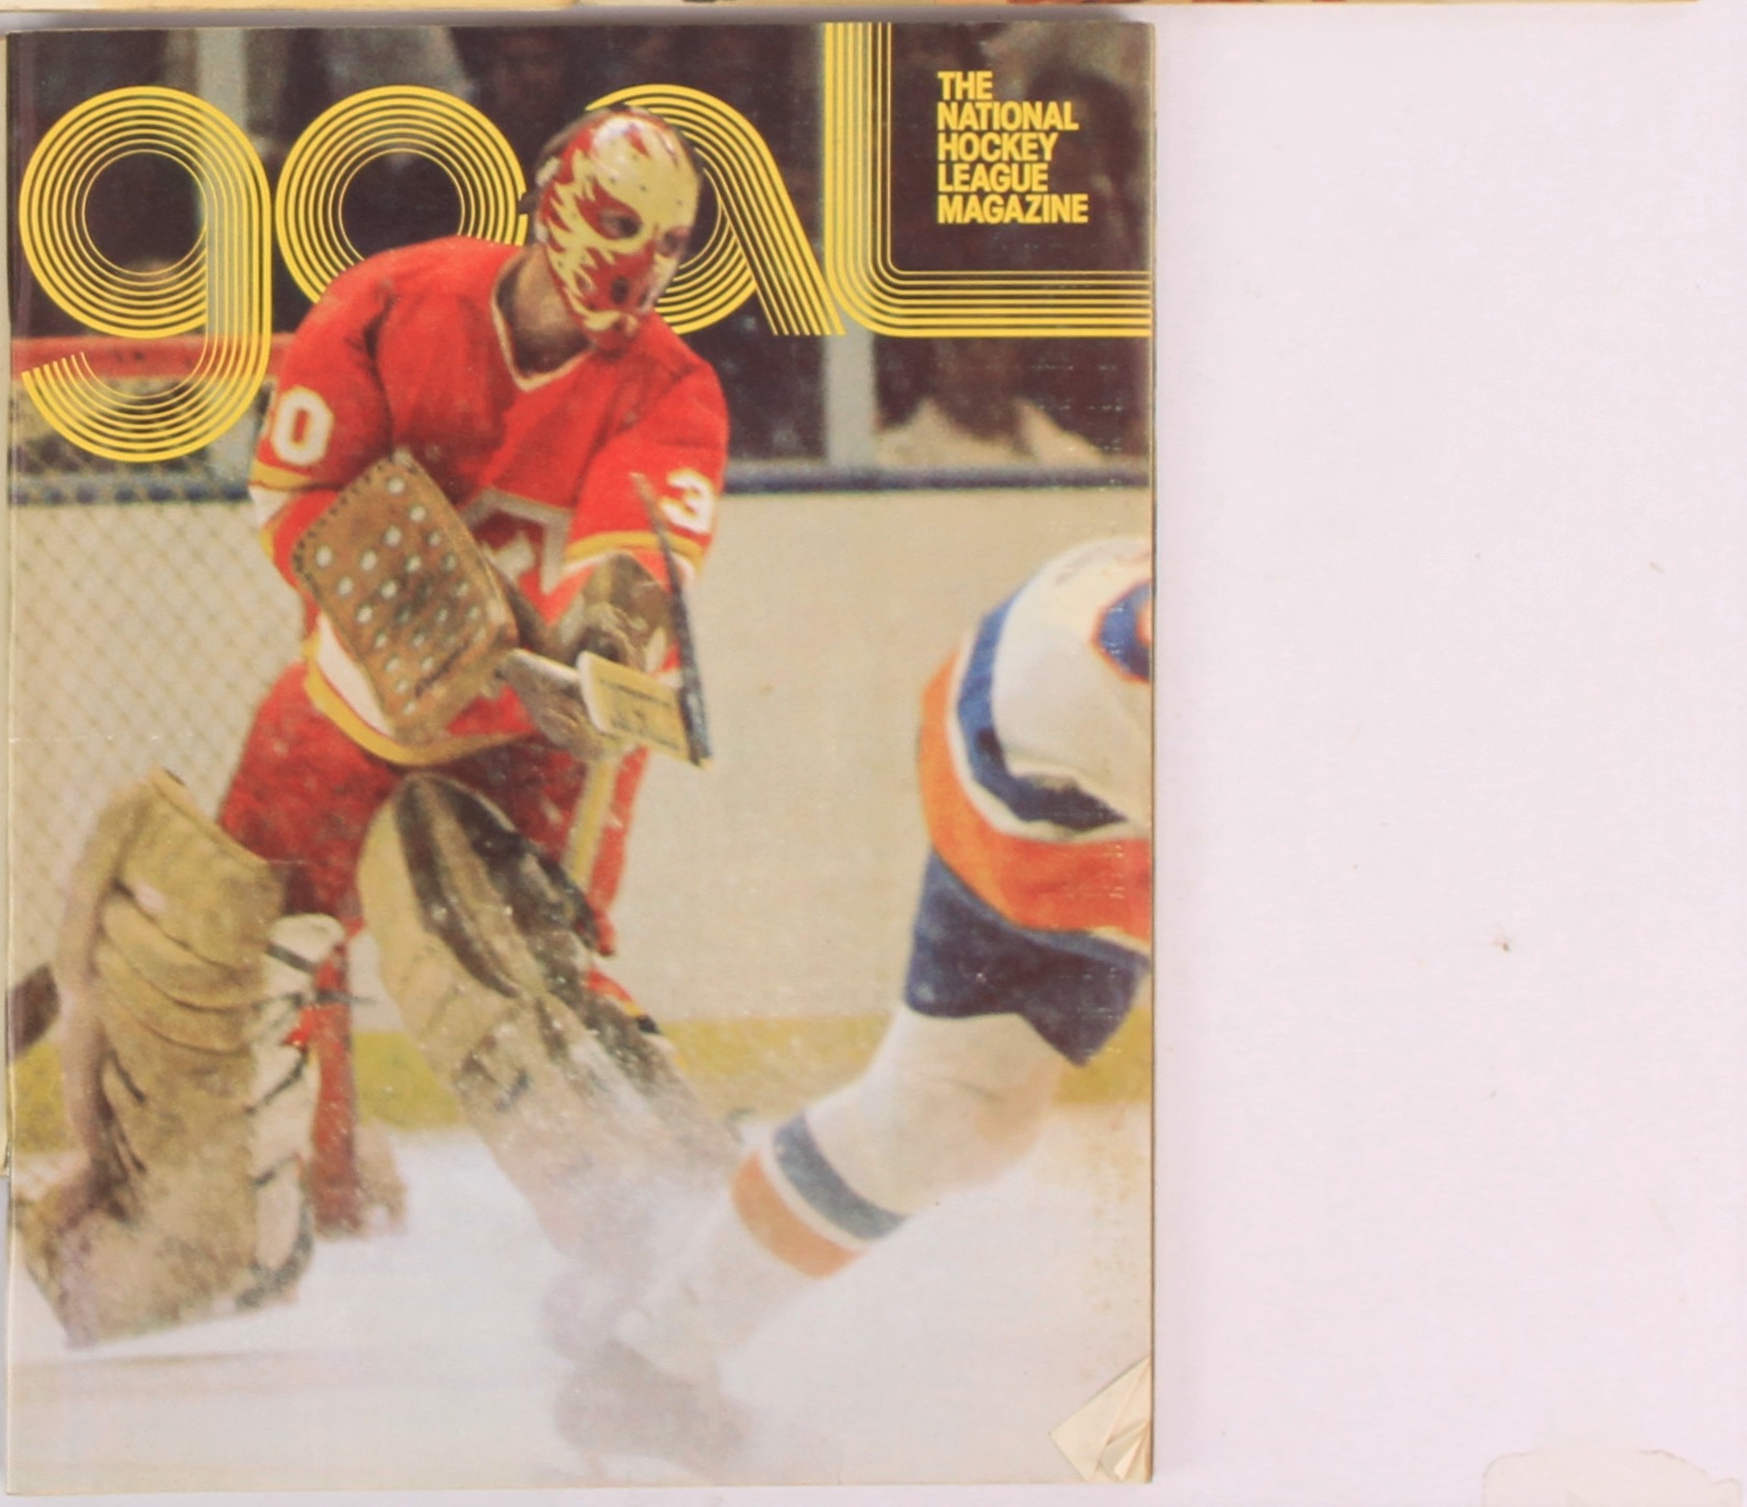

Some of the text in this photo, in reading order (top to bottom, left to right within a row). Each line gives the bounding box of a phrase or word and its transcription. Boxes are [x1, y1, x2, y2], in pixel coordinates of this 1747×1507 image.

[937, 70, 993, 101] THE
[937, 100, 1079, 131] NATIONAL
[937, 130, 1058, 161] HOCKEY
[938, 161, 1048, 193] LEAGUE
[937, 192, 1089, 224] MAGAZINE
[17, 22, 1154, 464] goal
